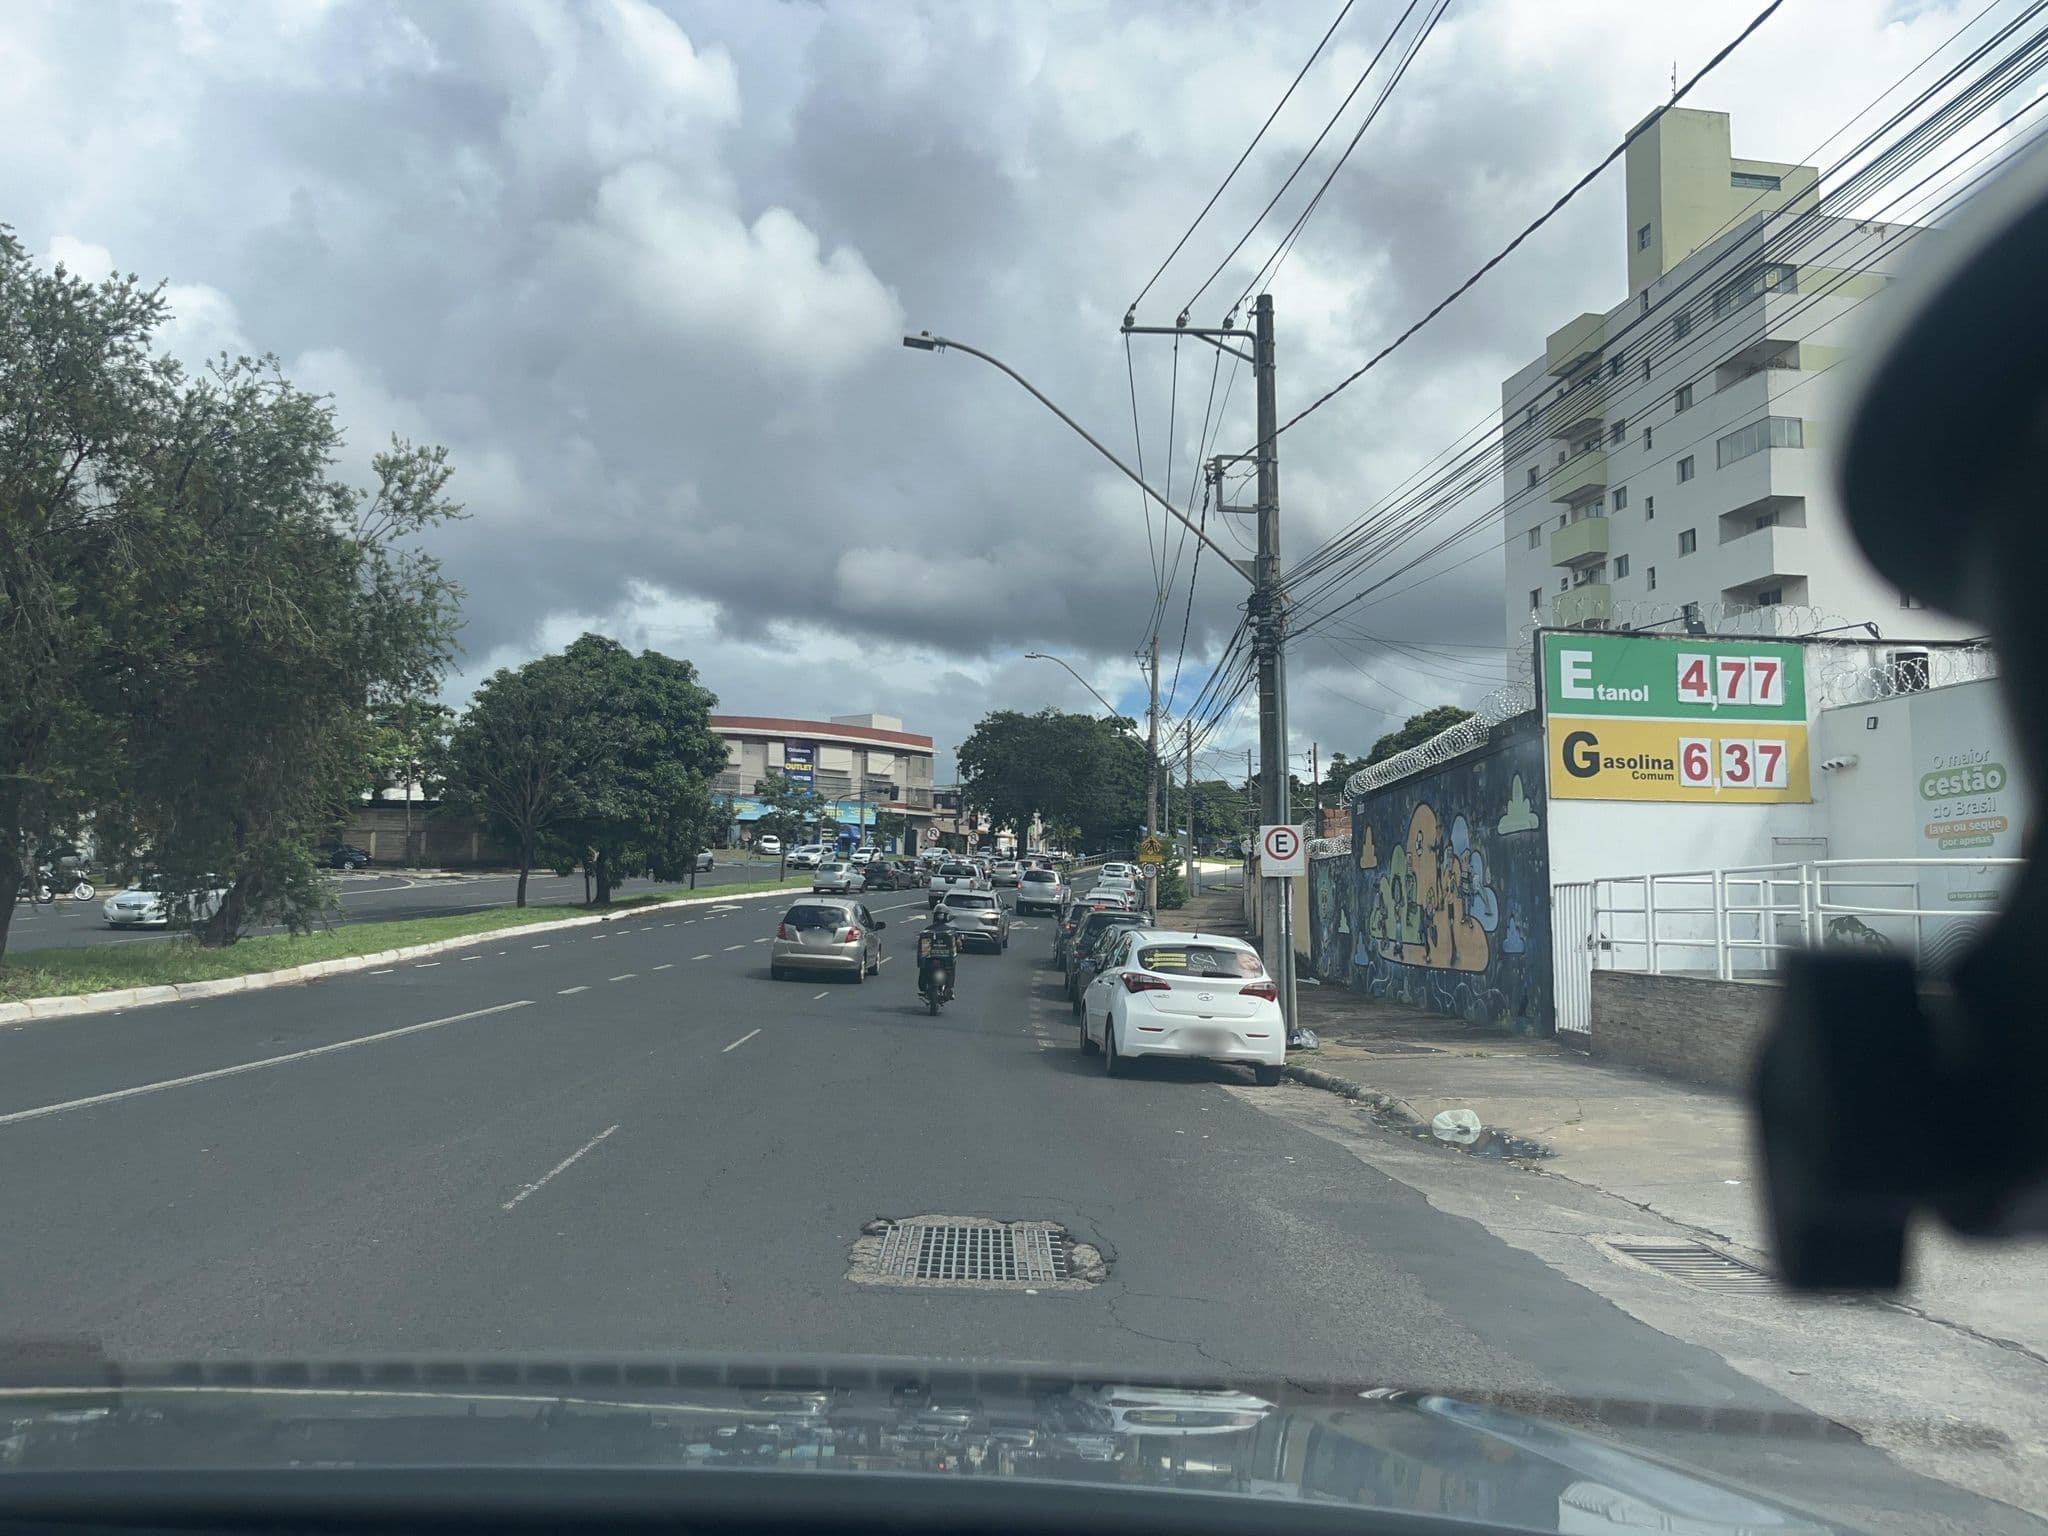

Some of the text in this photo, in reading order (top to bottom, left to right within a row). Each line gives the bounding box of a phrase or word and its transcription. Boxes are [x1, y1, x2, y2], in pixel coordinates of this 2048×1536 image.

[1560, 650, 1649, 701] Etanol
[1562, 731, 1674, 778] Gasolina
[1948, 749, 1990, 768] maior
[1632, 770, 1675, 781] Comum
[1924, 765, 2002, 797] cestão
[1933, 797, 1997, 819] do Brasil
[1929, 824, 1951, 835] lave
[1953, 822, 1967, 832] ou
[1275, 834, 1289, 853] E
[1942, 834, 1992, 849] por apenas
